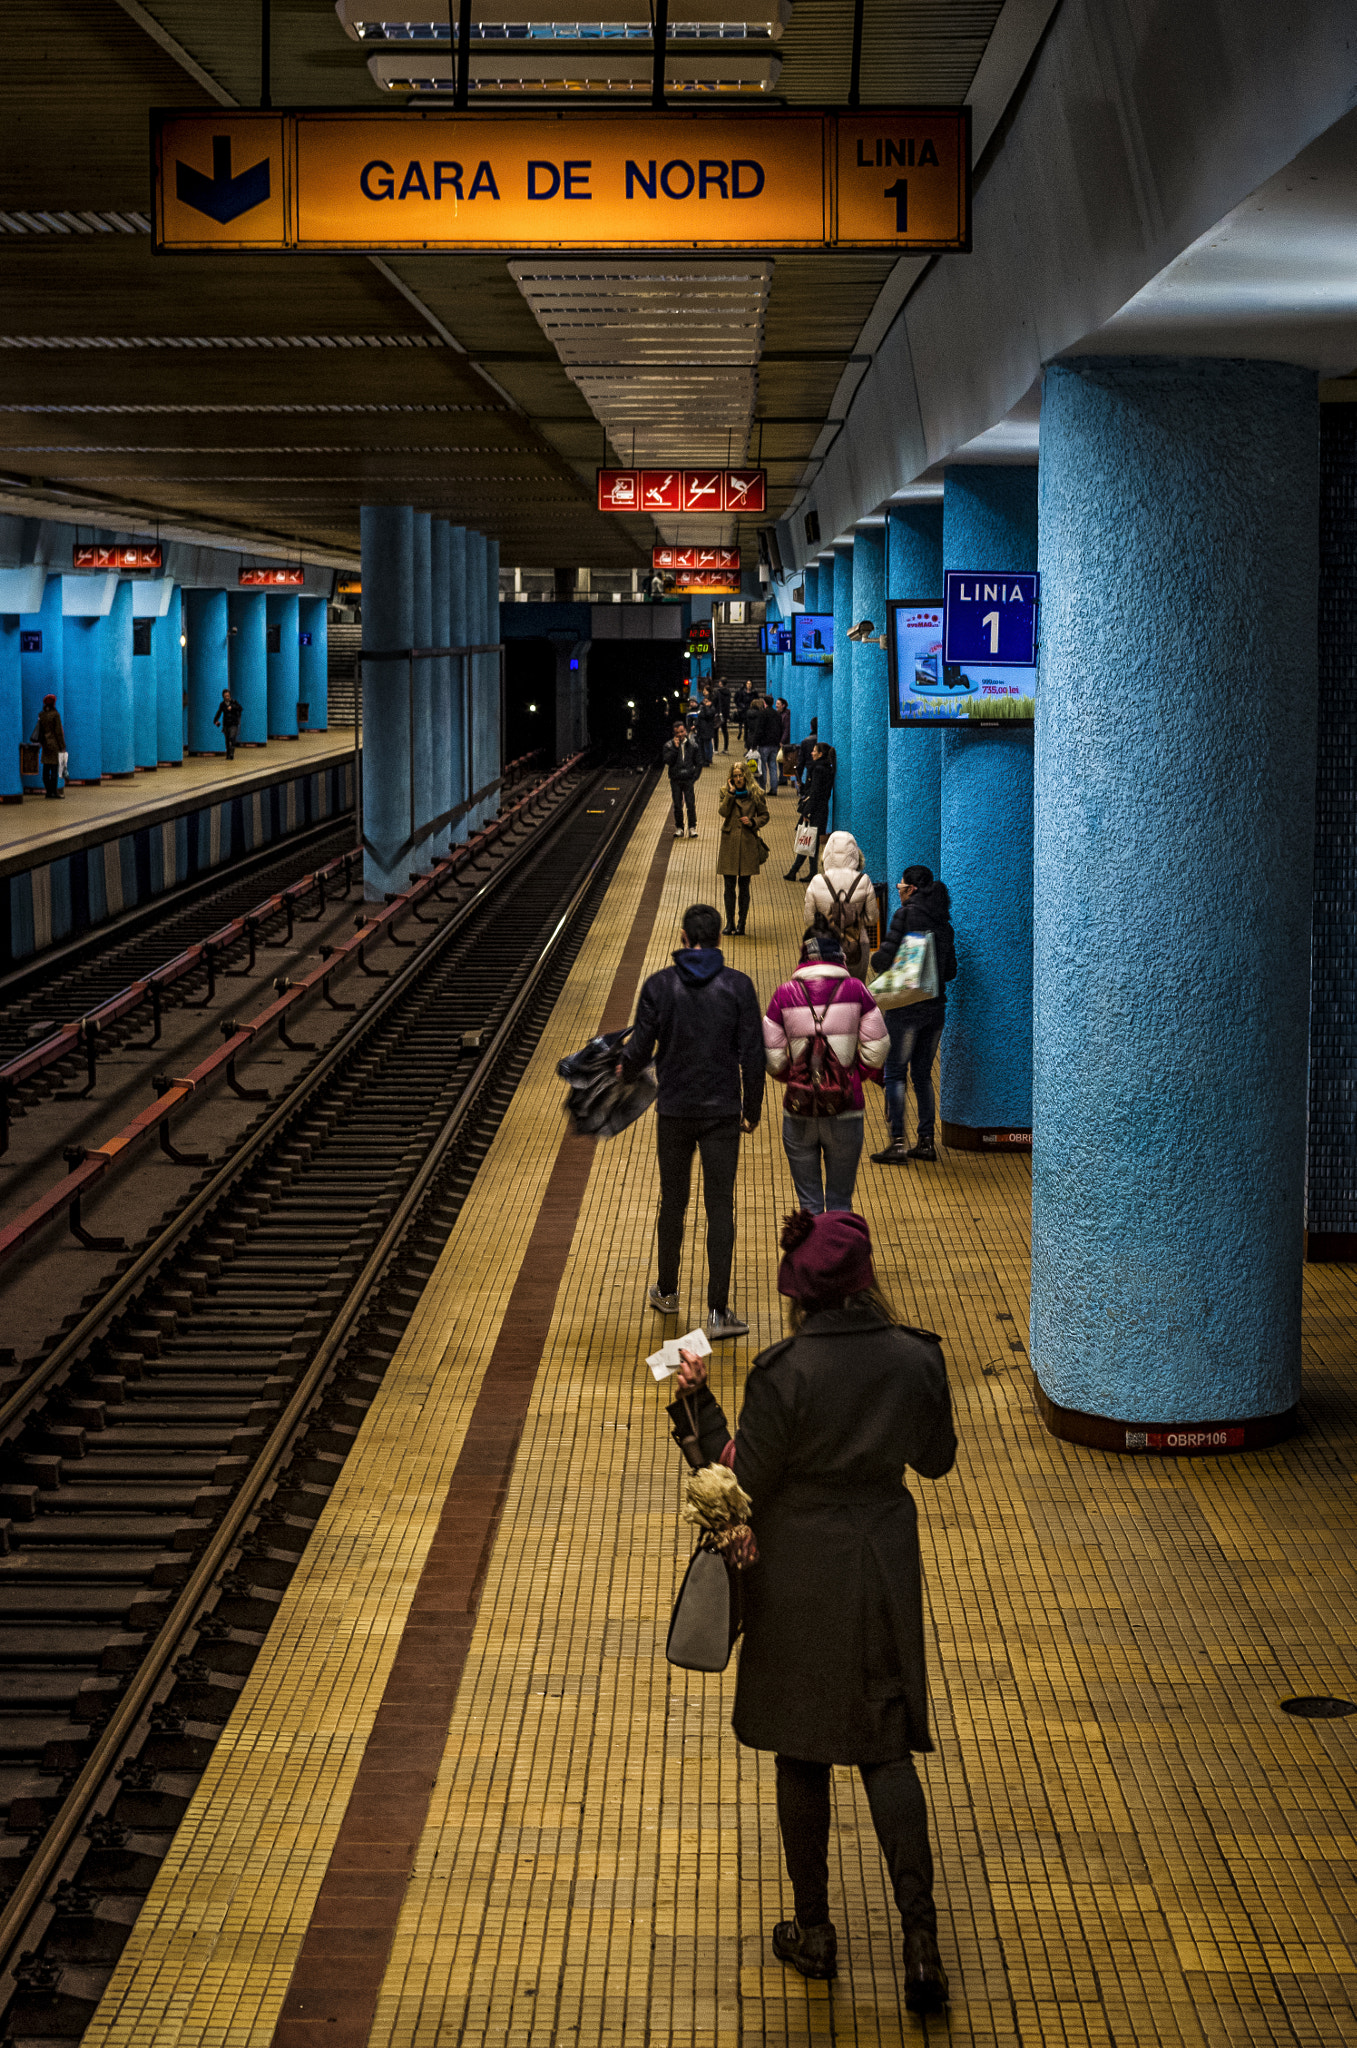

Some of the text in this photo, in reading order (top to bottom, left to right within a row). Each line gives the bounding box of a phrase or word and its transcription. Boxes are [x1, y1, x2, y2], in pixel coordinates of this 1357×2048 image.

[857, 139, 939, 167] LINIA
[360, 159, 765, 201] GARA DE NORD
[884, 179, 907, 232] 1
[960, 583, 1024, 602] LINIA
[982, 611, 1000, 653] 1
[1167, 1432, 1227, 1447] OBRP106
